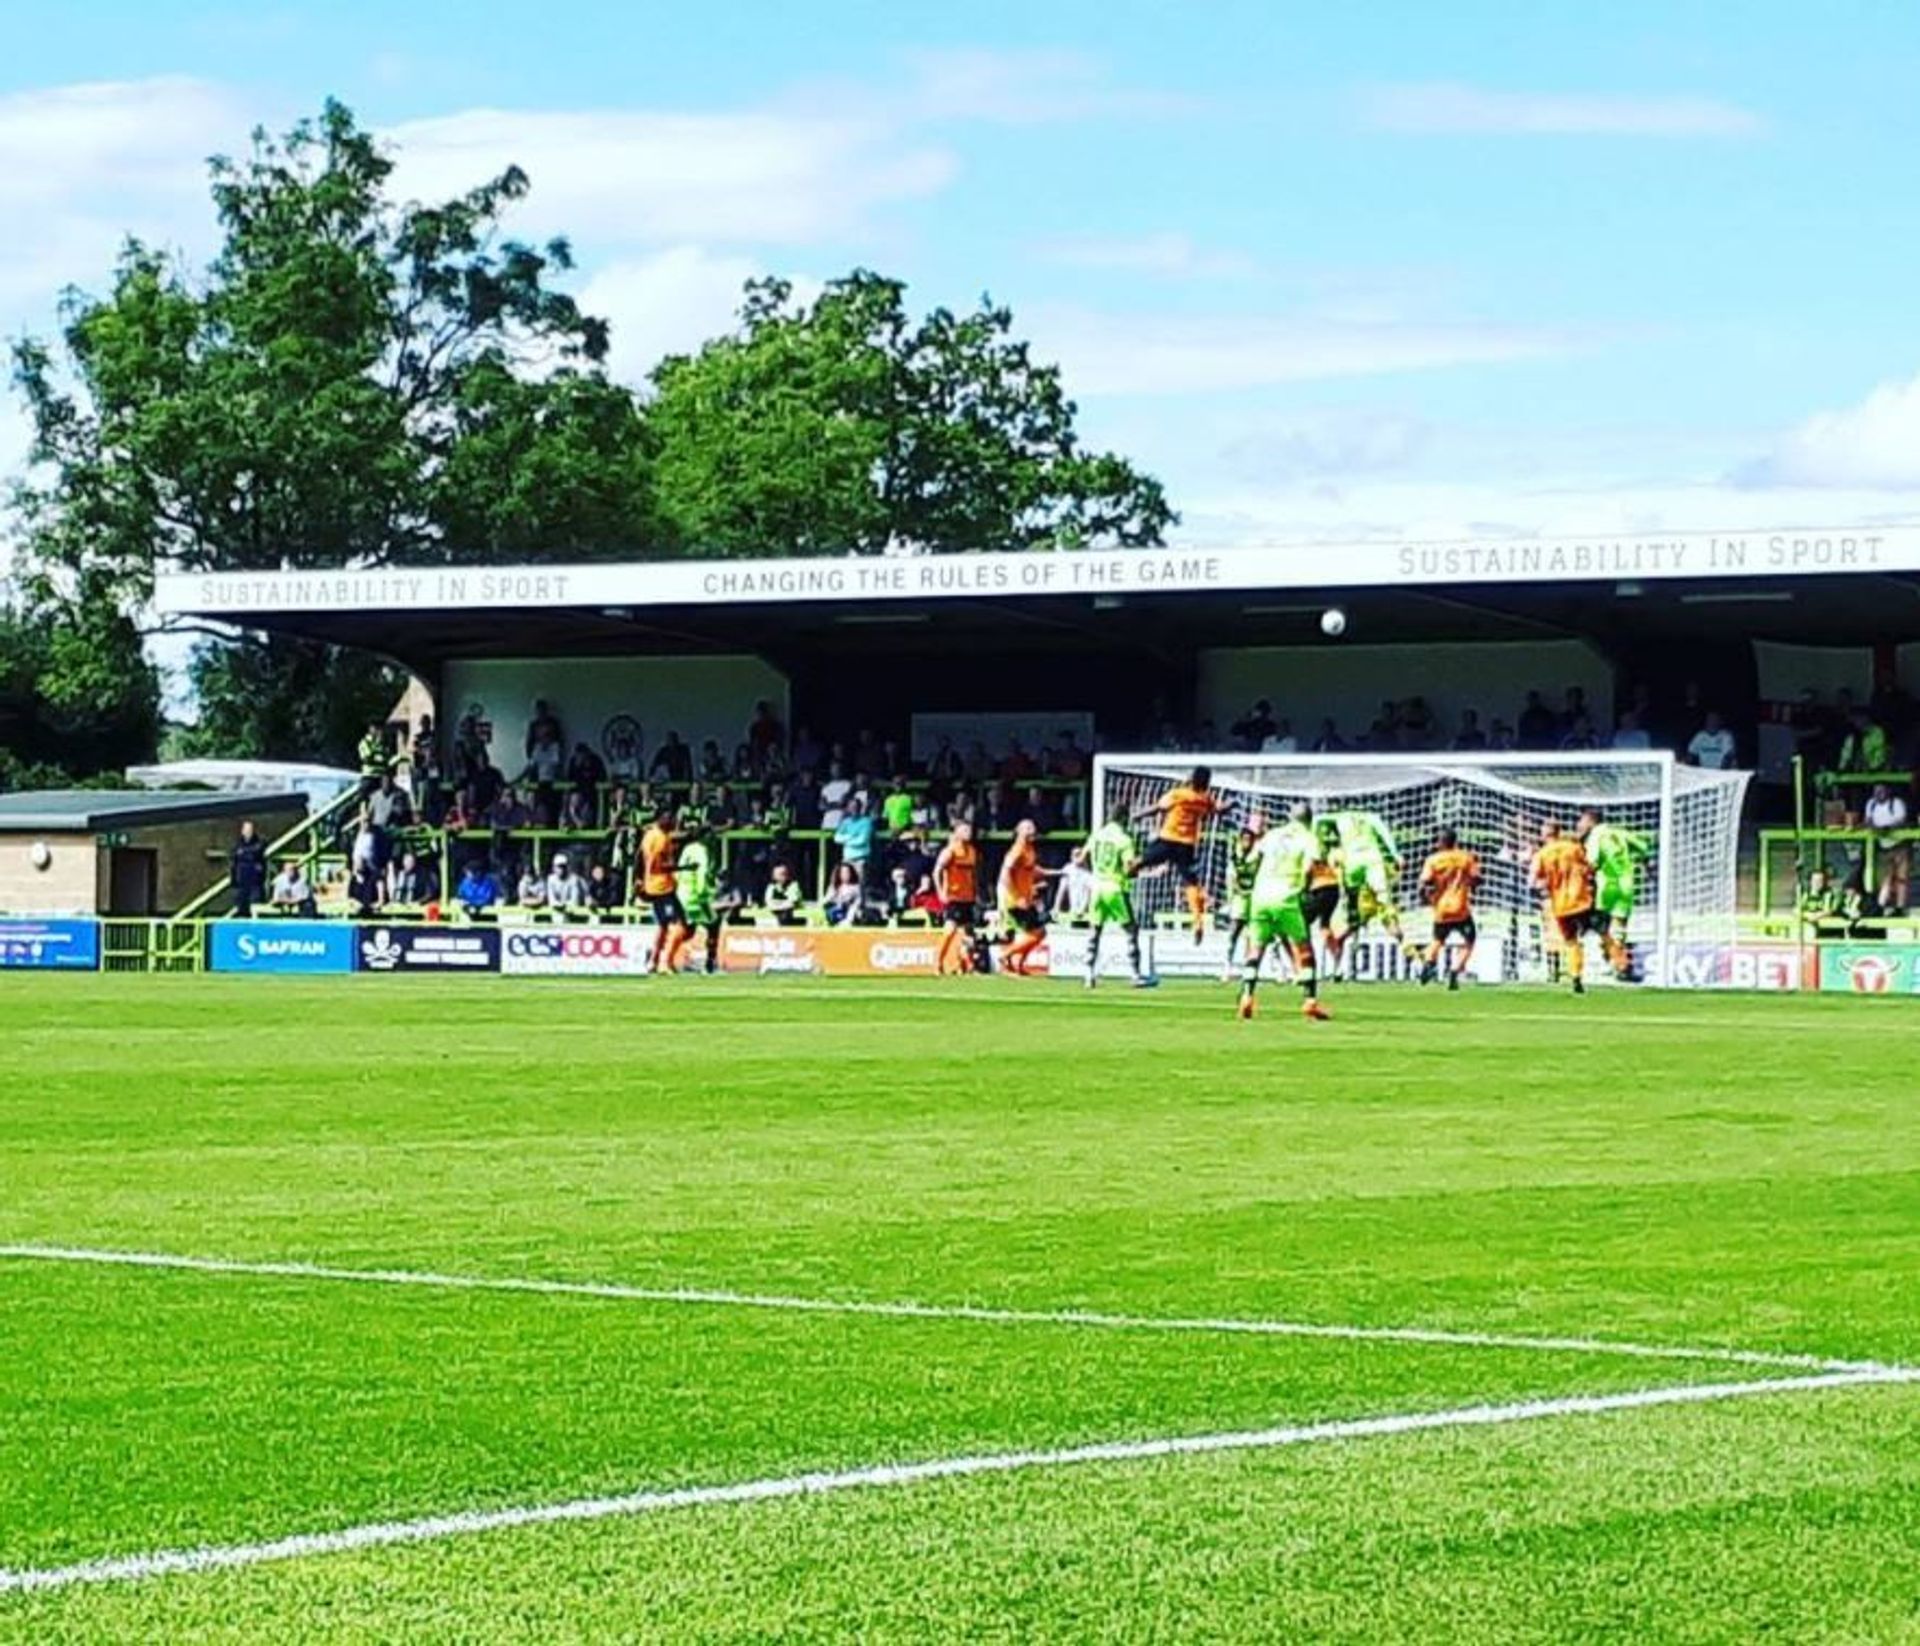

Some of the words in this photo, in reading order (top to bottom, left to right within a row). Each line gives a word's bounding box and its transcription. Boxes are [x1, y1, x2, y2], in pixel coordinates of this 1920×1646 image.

[1399, 543, 1687, 575] SUSTAINABILITY
[1709, 538, 1747, 567] IN
[1768, 536, 1886, 566] SPORT
[201, 577, 423, 604] SUSTAINABILITY
[438, 576, 467, 600] IN
[481, 575, 569, 599] SPORT
[703, 571, 845, 595] CHANGING
[858, 567, 905, 590] THE
[920, 564, 1009, 588] RULES
[1022, 562, 1057, 586] OF
[1071, 559, 1124, 583] THE
[1138, 557, 1220, 582] GAME
